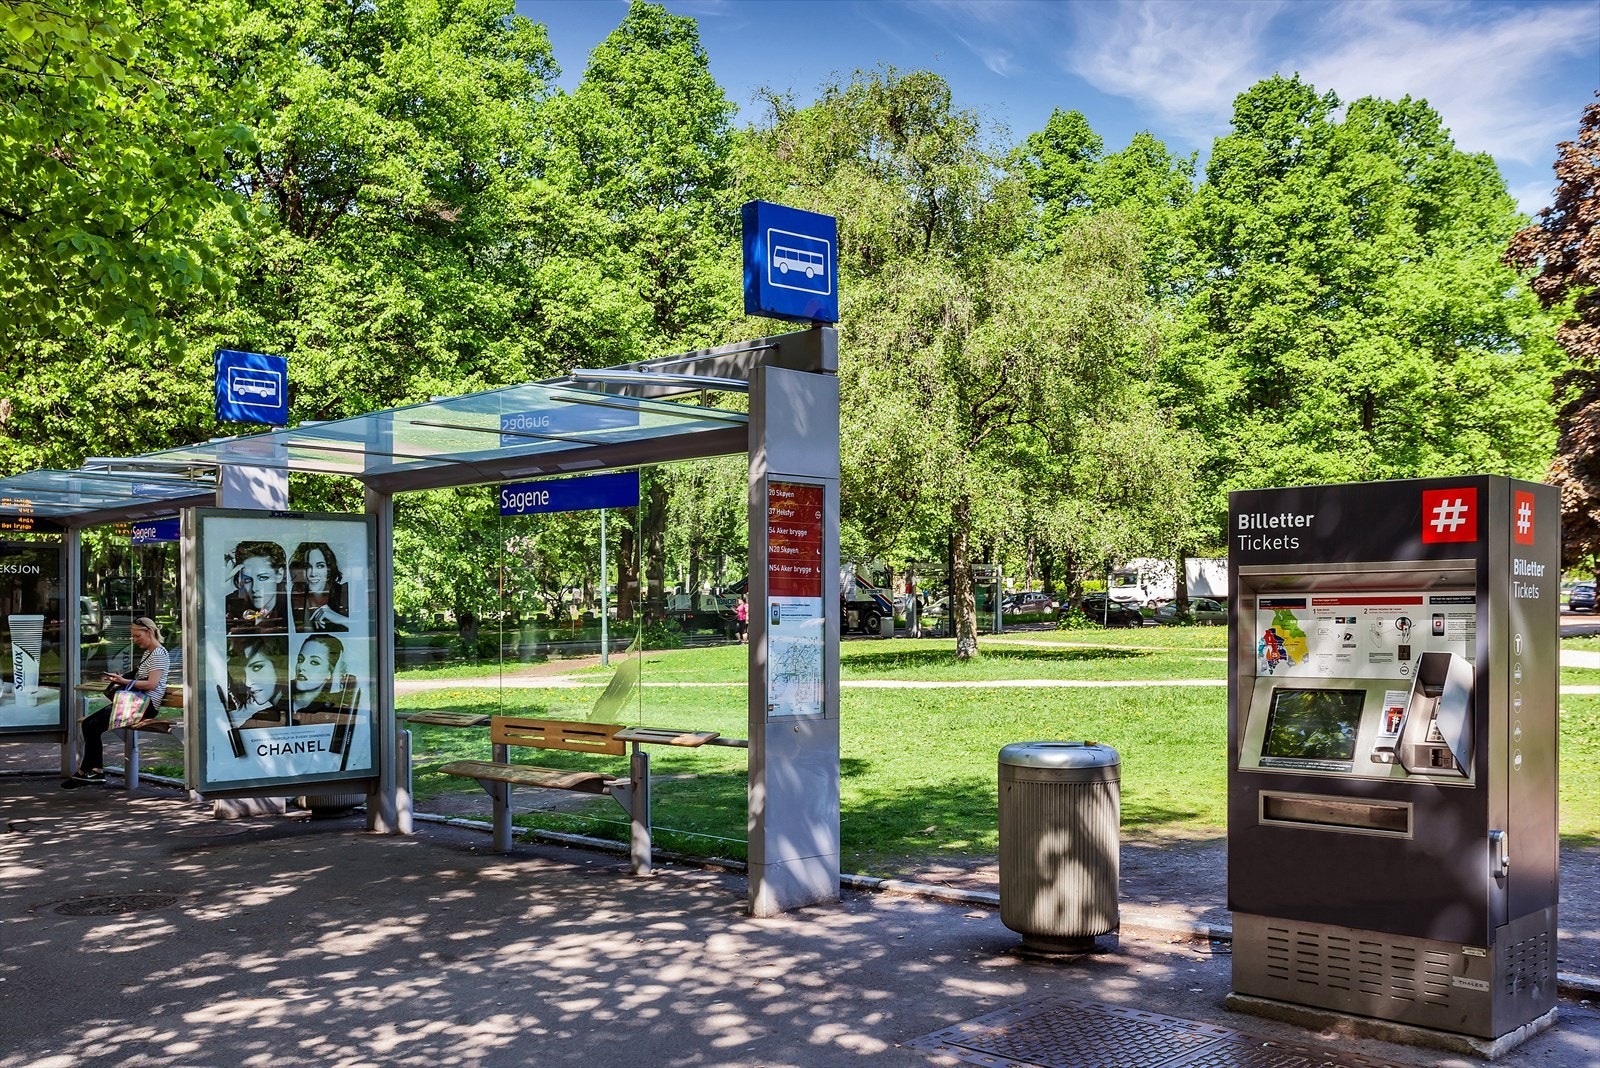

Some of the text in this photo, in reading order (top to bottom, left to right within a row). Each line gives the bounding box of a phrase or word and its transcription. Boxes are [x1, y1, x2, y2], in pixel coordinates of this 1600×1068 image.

[501, 489, 549, 512] Sagene
[776, 490, 794, 498] Skøyen
[1238, 512, 1314, 530] Billetter
[132, 526, 156, 542] Sagene
[790, 528, 807, 537] brygge
[780, 546, 799, 554] Skøyen
[1238, 534, 1300, 550] Tickets
[794, 566, 812, 574] brygge
[1514, 558, 1545, 577] Billetter
[1513, 581, 1540, 599] Tickets
[256, 740, 326, 756] CHANEL
